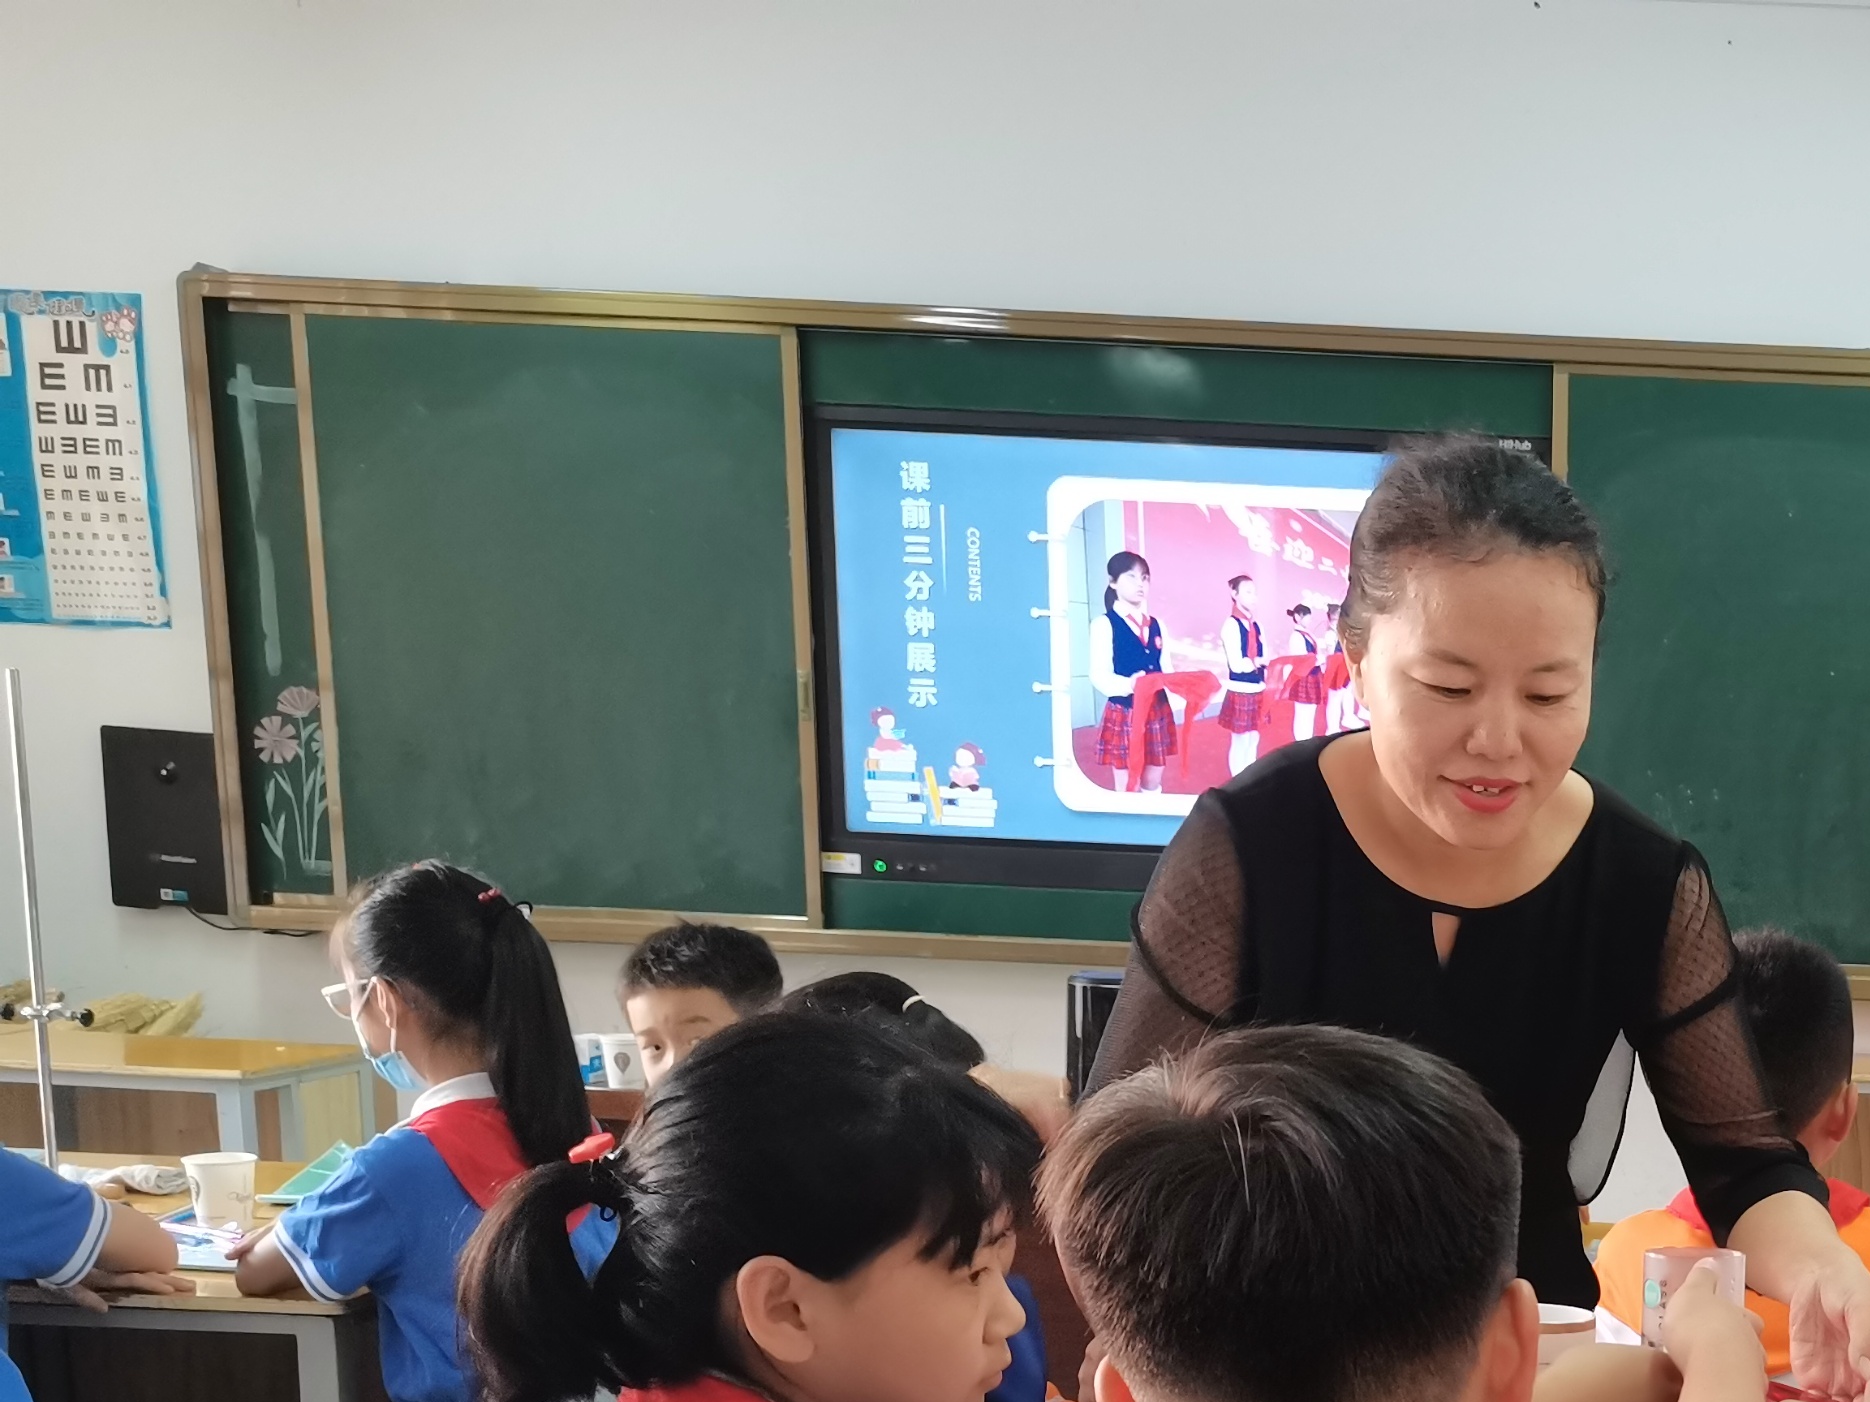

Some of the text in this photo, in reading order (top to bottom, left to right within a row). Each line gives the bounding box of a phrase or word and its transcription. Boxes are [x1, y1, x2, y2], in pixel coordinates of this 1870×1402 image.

[900, 461, 938, 708] 课前三分钟展示
[966, 527, 982, 602] CONTENTS
